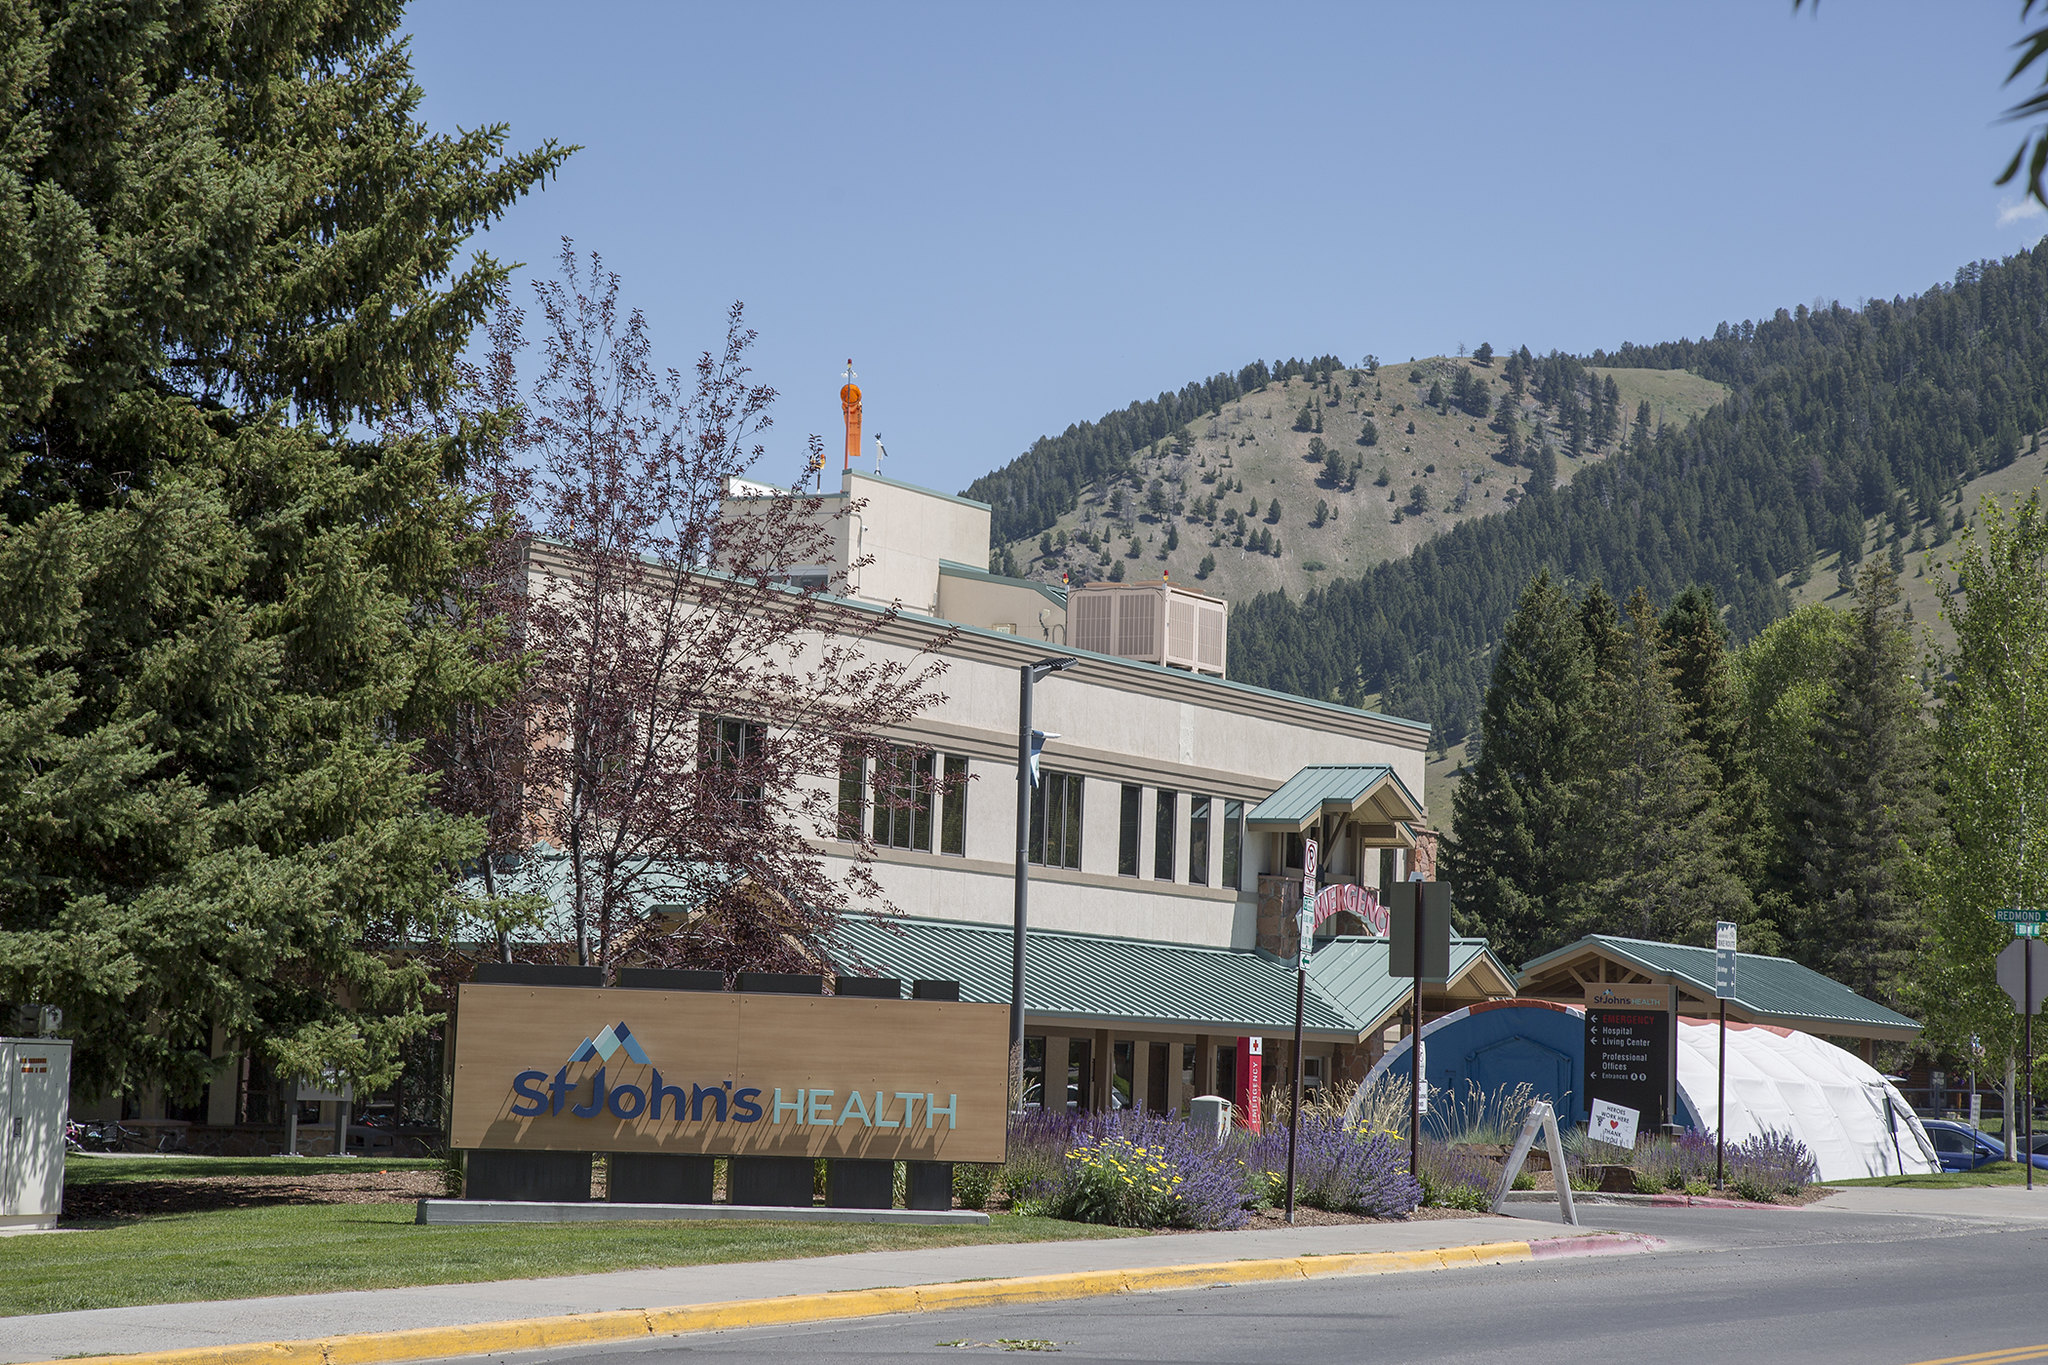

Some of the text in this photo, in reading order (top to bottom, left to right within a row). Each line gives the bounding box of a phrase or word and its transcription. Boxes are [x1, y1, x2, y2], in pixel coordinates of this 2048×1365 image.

[1313, 884, 1390, 936] MERGENC
[1997, 911, 2041, 921] REDMOND
[1631, 998, 1661, 1006] HEALTH
[1602, 1014, 1655, 1025] EMERGENCY
[1602, 1026, 1633, 1036] Hospital
[1602, 1037, 1650, 1047] Living Center
[1602, 1052, 1647, 1062] Professional
[1602, 1062, 1627, 1071] Offices
[773, 1087, 957, 1130] HEALTH
[1606, 1106, 1626, 1116] HEROES
[1601, 1112, 1630, 1124] WORK HERE
[1604, 1128, 1621, 1138] THANK
[1605, 1136, 1618, 1144] YOU
